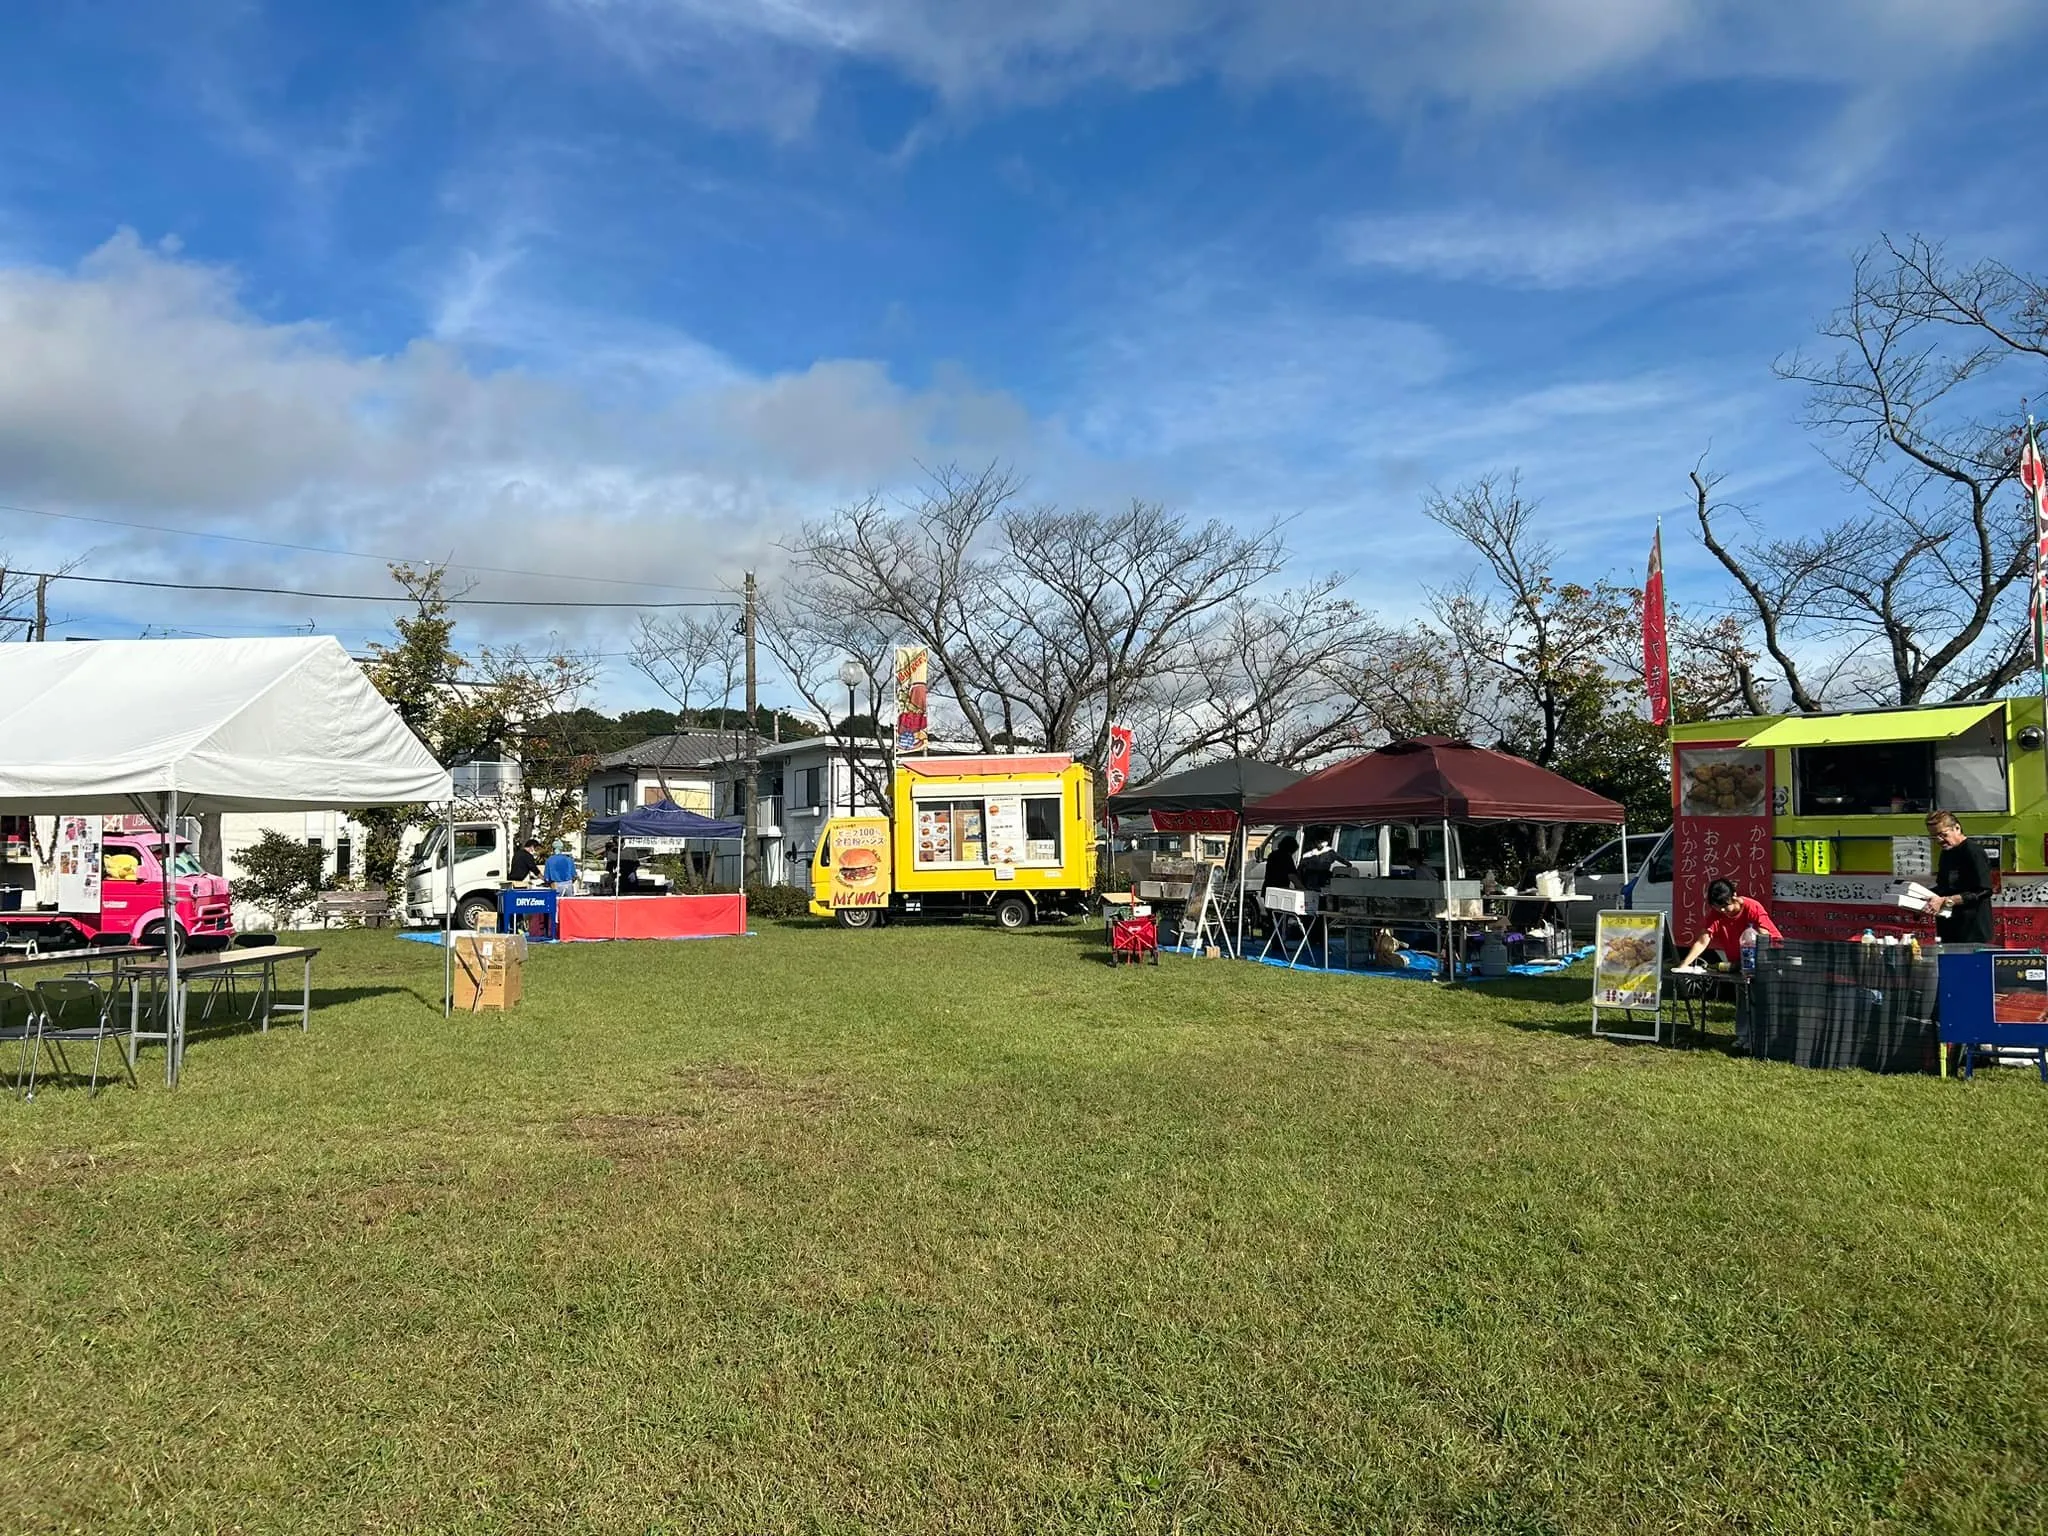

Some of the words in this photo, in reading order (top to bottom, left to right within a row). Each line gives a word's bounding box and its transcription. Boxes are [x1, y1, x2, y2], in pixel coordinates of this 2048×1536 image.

[1681, 820, 1699, 945] いかがでしょう
[1748, 824, 1767, 898] かわいい
[855, 891, 886, 907] WAY
[1995, 958, 2046, 967] フランクフルト
